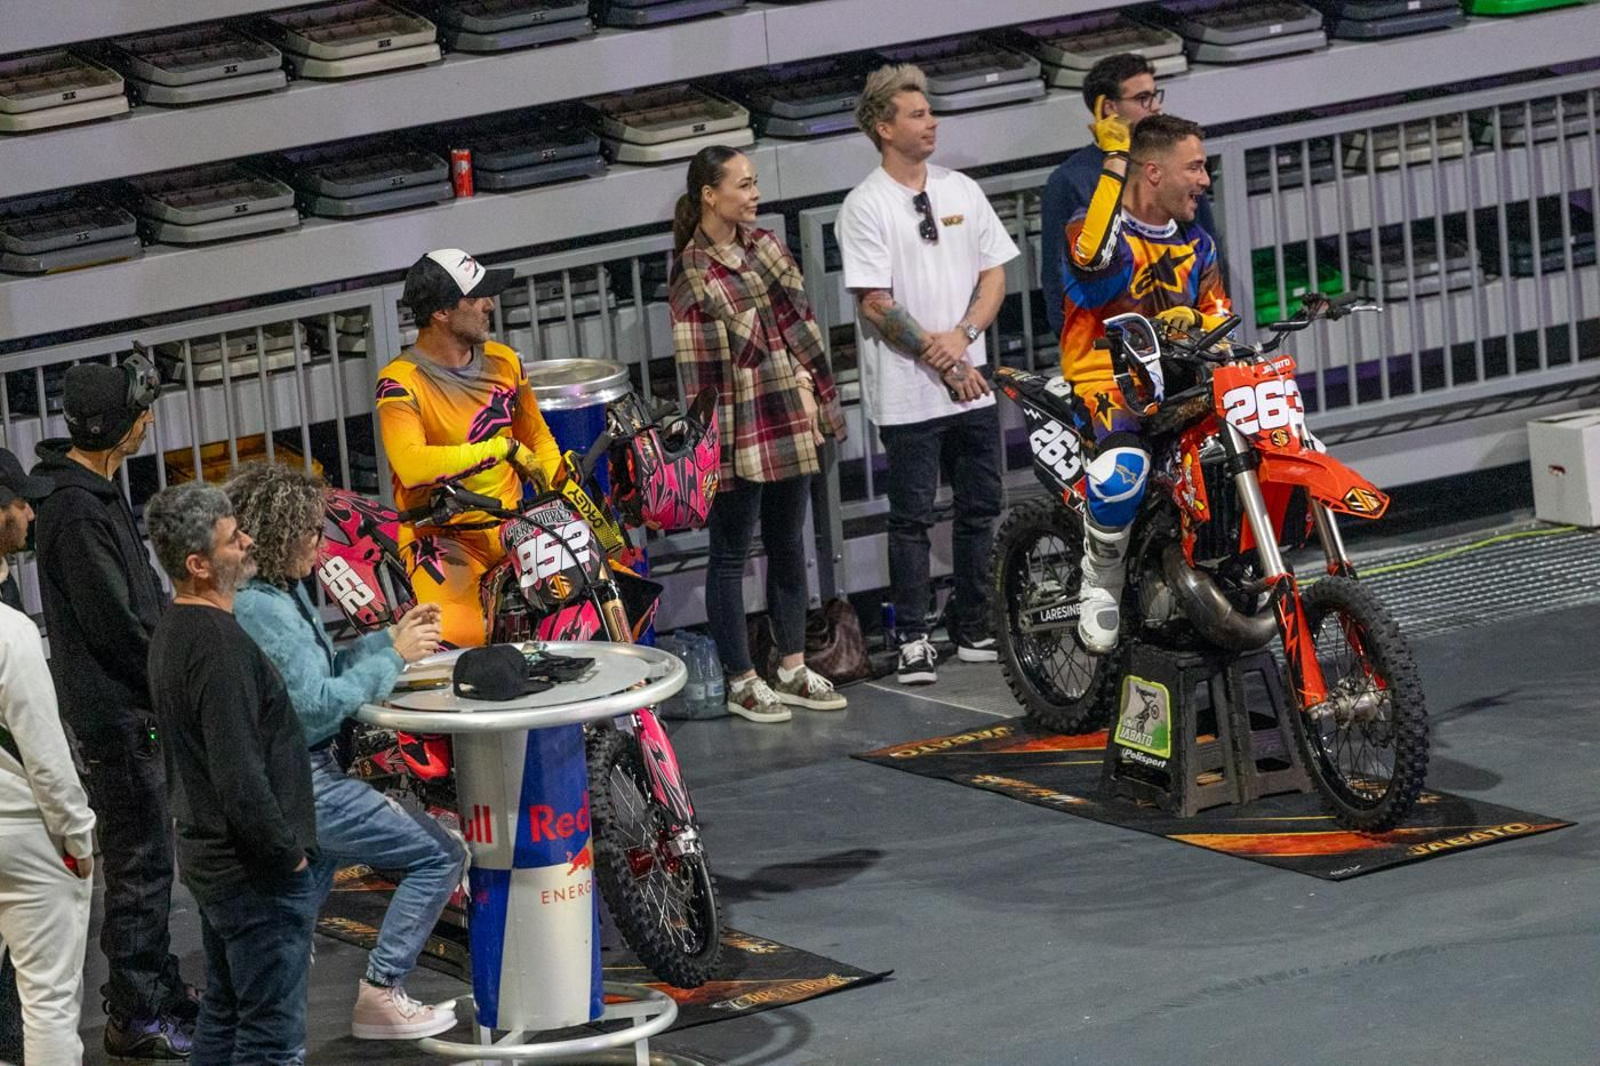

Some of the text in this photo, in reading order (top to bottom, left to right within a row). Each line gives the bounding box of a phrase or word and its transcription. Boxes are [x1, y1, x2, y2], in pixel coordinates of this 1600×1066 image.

[1222, 379, 1305, 436] 263
[1029, 420, 1082, 481] 263
[567, 489, 604, 530] OAKLEY
[516, 520, 591, 588] 952
[318, 556, 376, 616] 952
[460, 804, 493, 844] ull
[529, 788, 591, 844] Red
[1408, 822, 1531, 856] JABATO
[541, 880, 592, 906] ENERG
